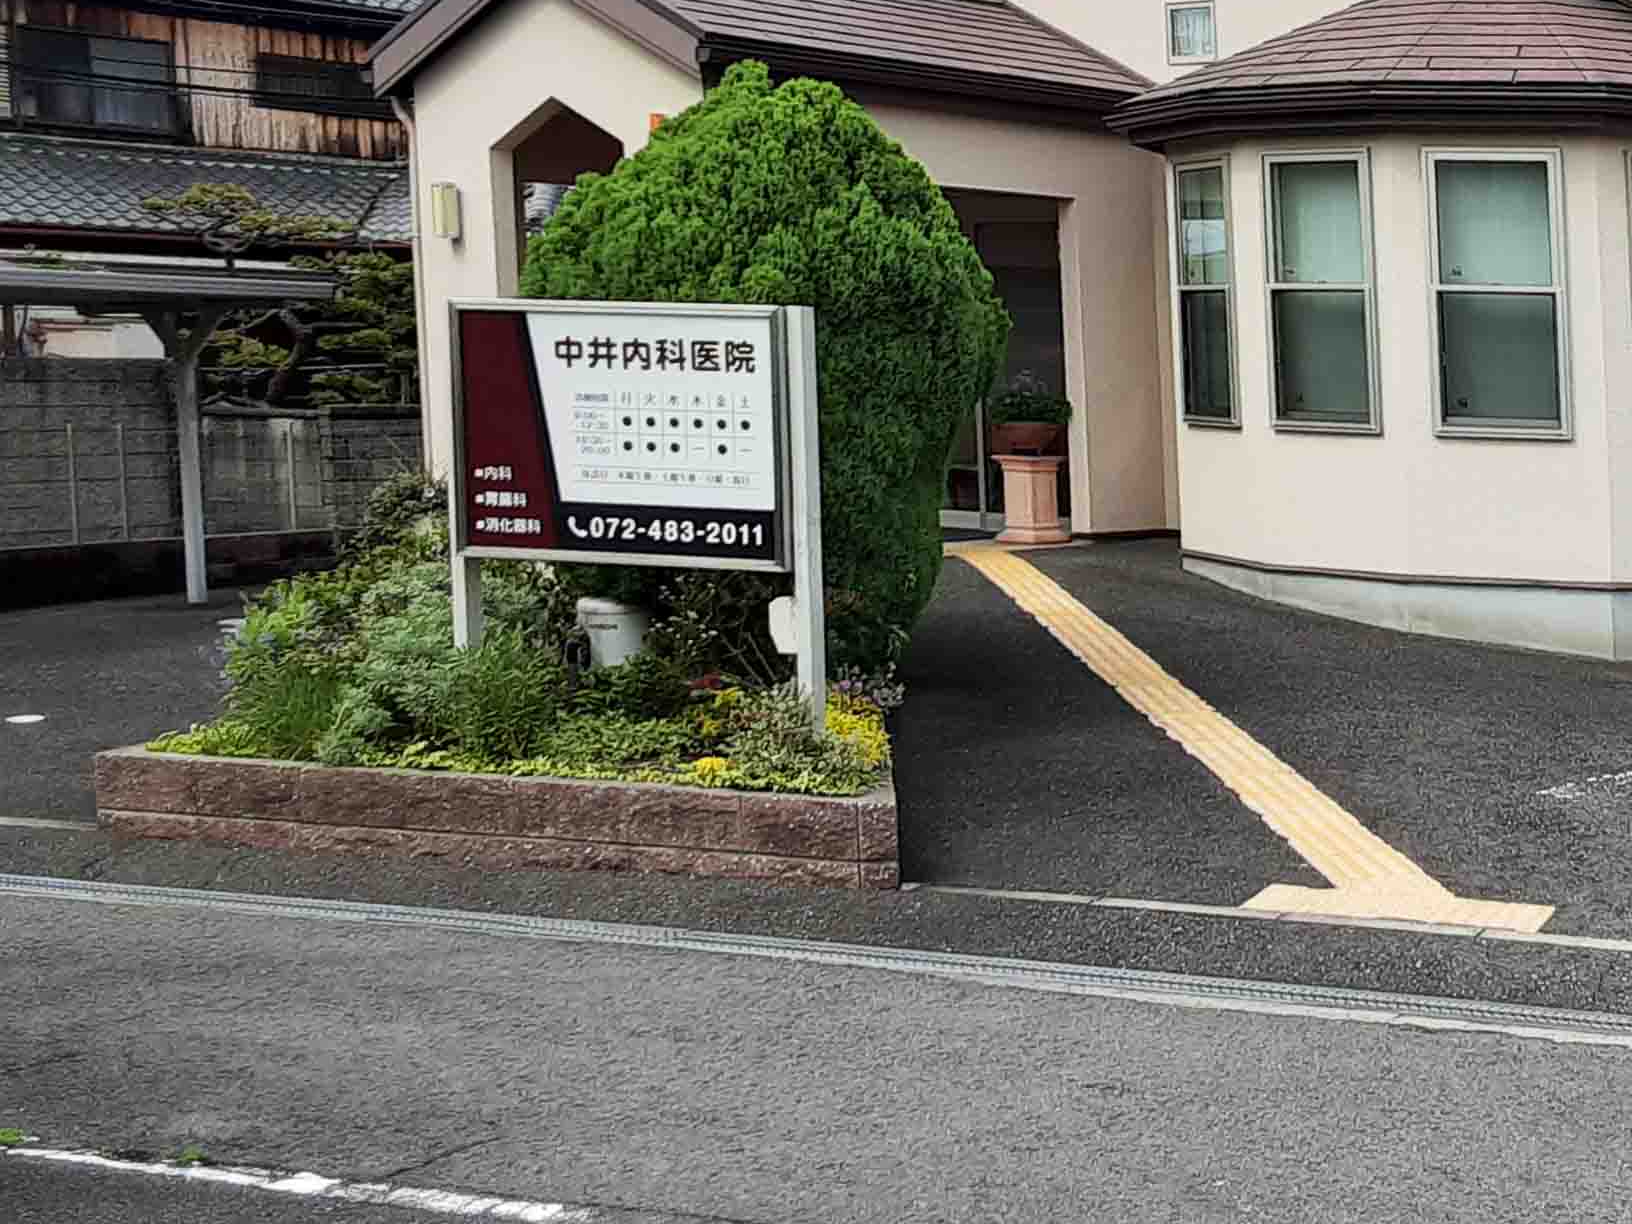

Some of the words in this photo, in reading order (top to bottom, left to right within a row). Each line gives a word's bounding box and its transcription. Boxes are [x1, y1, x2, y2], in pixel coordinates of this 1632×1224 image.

[554, 336, 755, 373] 中井内科医院
[484, 465, 512, 481] 内科
[589, 516, 763, 546] 072-483-2011
